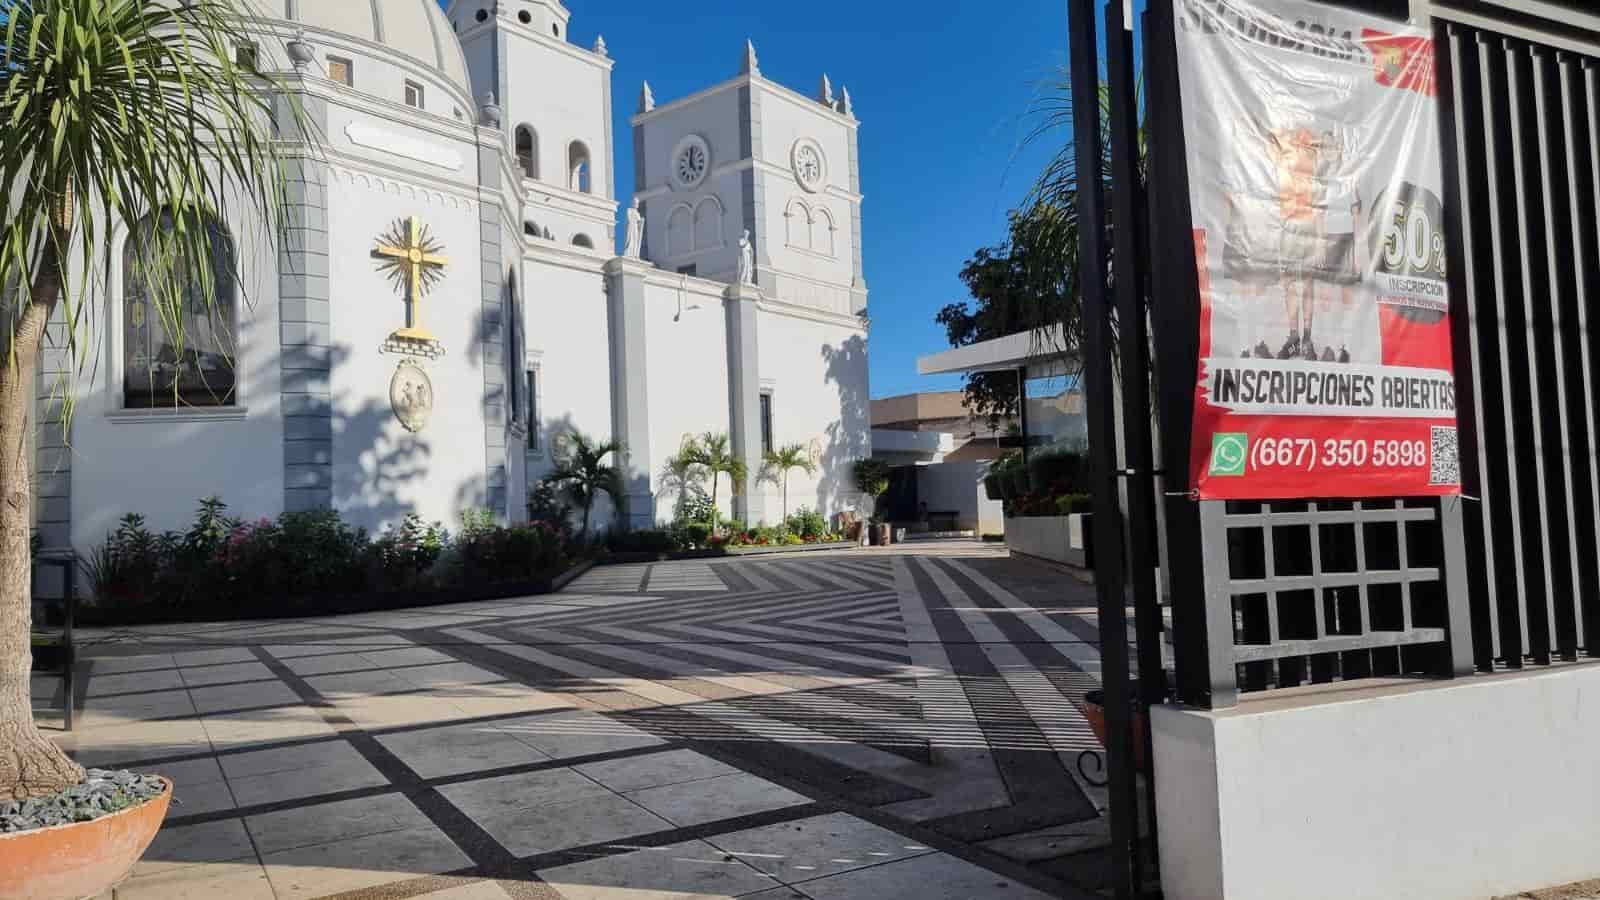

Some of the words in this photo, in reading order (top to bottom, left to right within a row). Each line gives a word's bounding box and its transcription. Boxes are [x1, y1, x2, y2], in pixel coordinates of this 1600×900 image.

[1213, 368, 1375, 407] INSCRIPCIONES
[1381, 376, 1456, 411] ABIERTAS
[1250, 437, 1318, 471] (667)
[1321, 439, 1368, 467] 350
[1372, 440, 1427, 467] 5898
